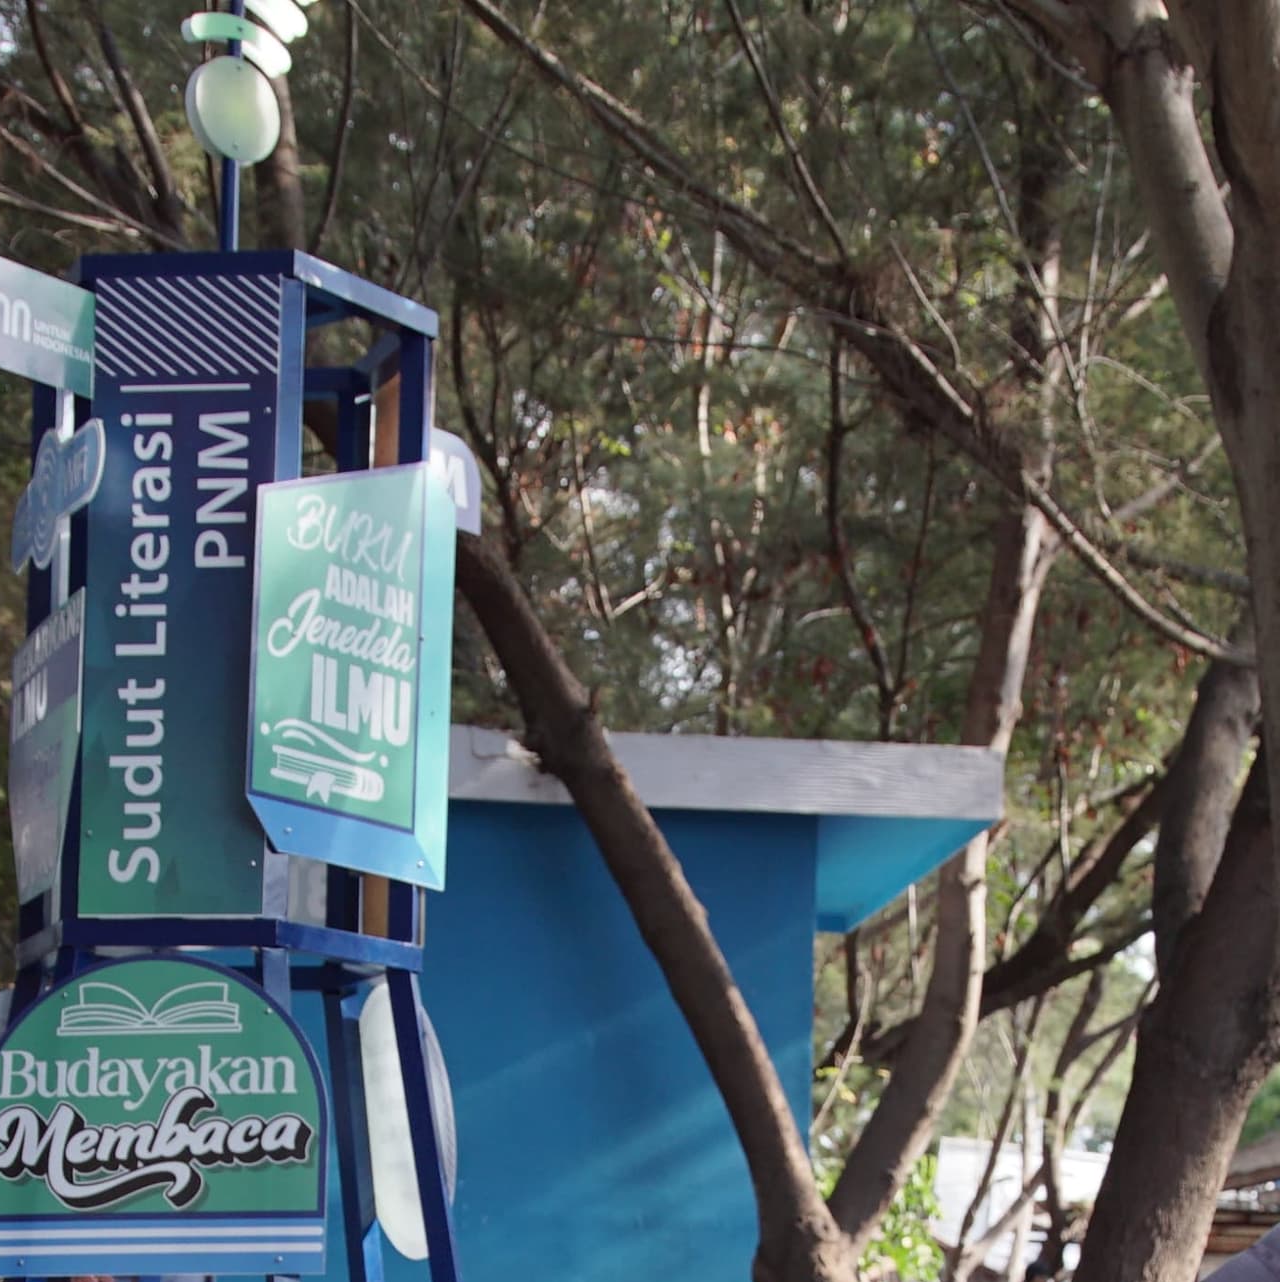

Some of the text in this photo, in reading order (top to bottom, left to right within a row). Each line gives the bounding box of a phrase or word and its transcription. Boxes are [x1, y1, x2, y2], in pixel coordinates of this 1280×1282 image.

[33, 332, 92, 363] INDONESIA
[194, 411, 250, 568] PNM
[287, 494, 412, 582] BUKU
[324, 564, 413, 627] ADALAH
[108, 413, 173, 883] Sudut Literasi
[311, 653, 411, 746] ILMU
